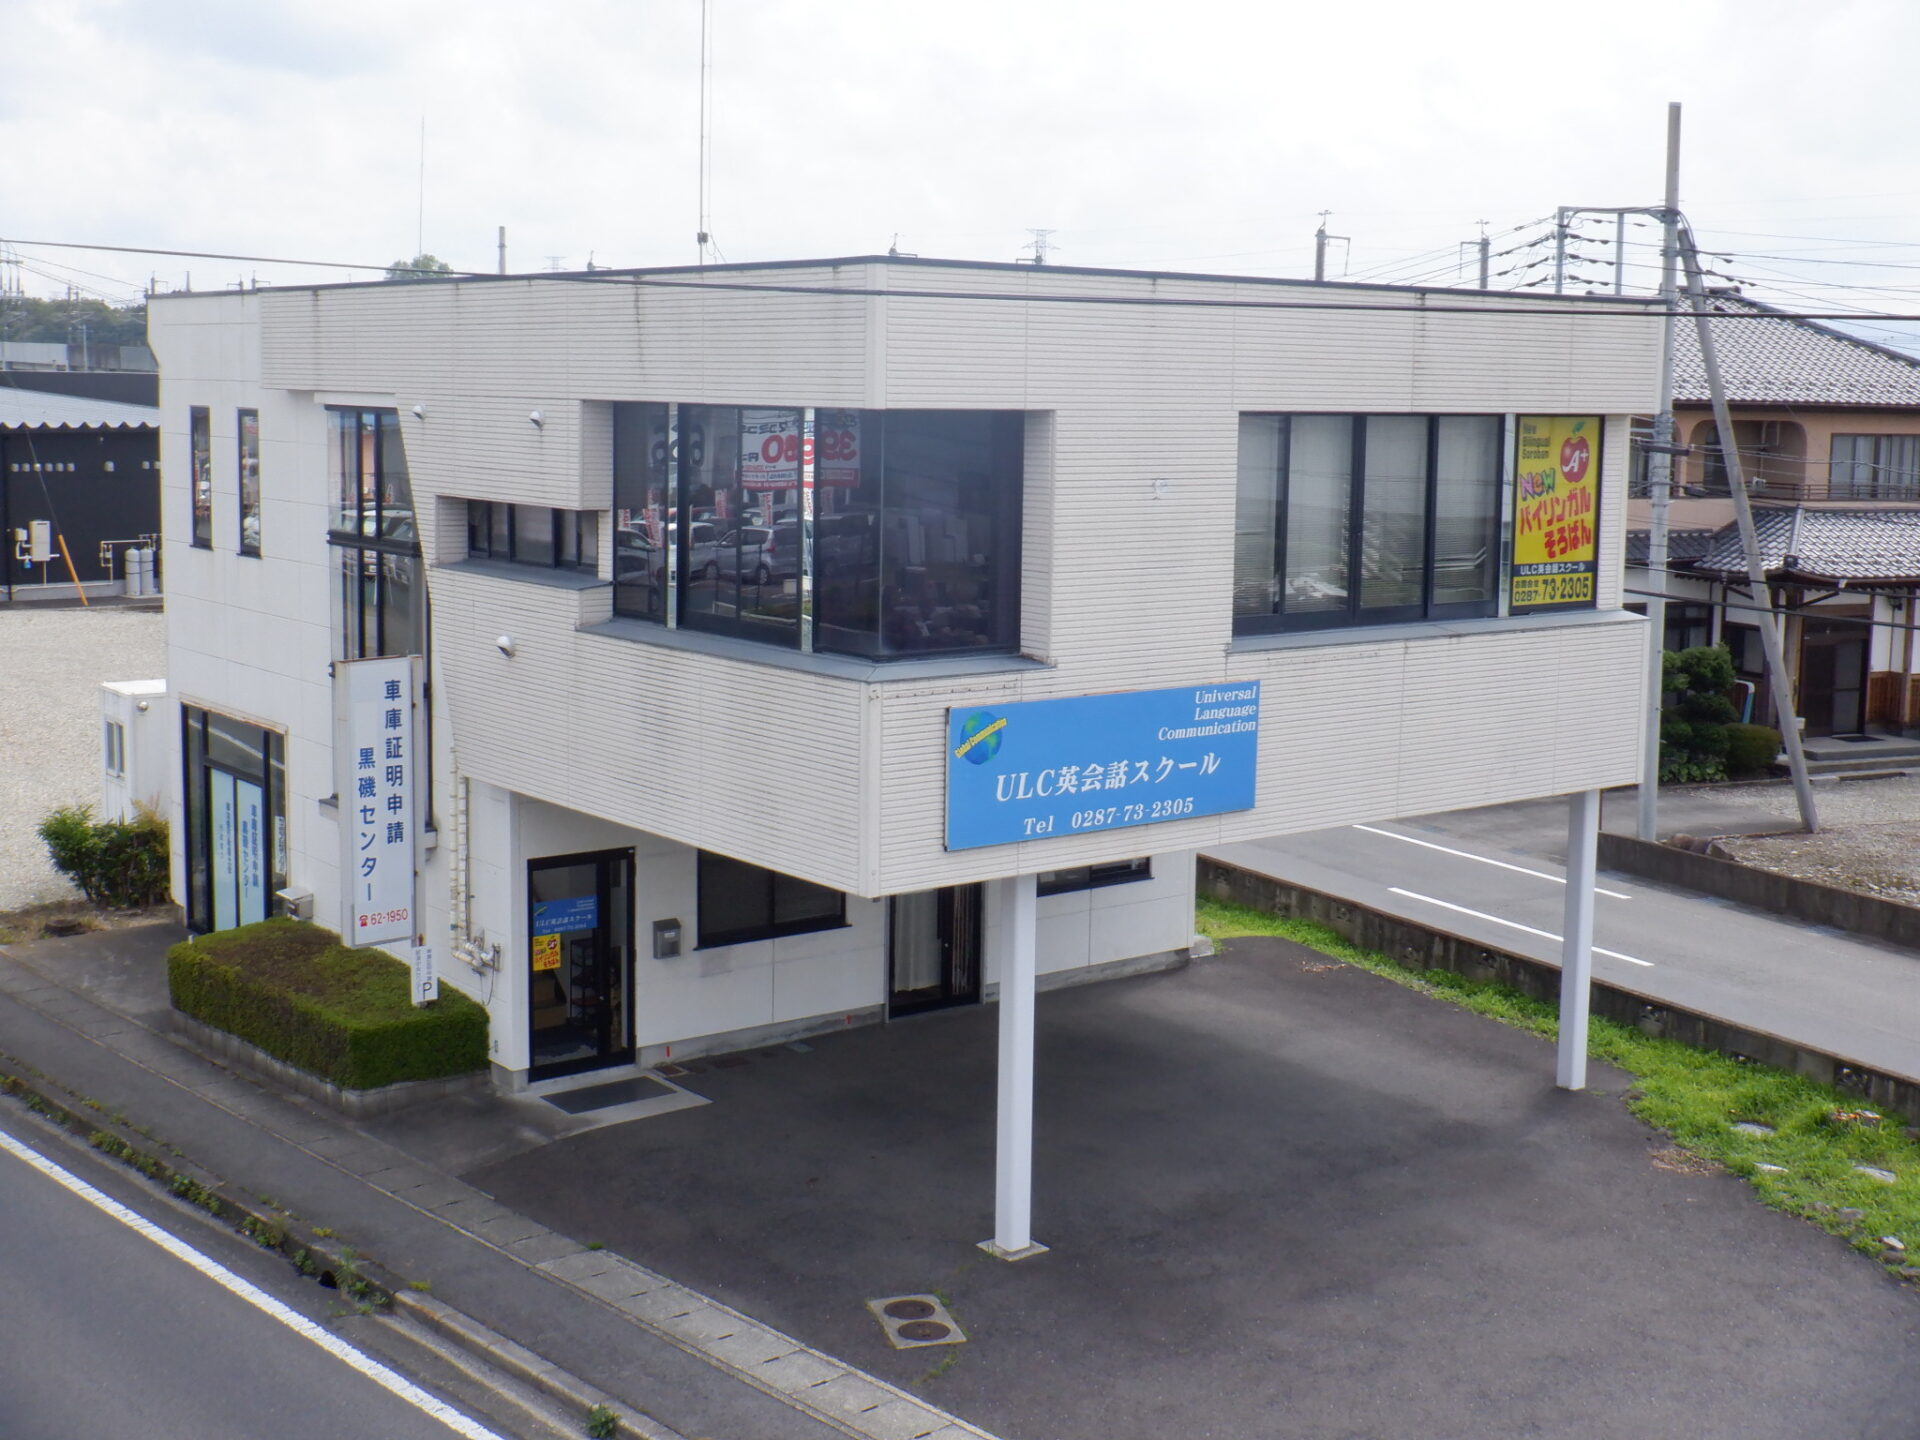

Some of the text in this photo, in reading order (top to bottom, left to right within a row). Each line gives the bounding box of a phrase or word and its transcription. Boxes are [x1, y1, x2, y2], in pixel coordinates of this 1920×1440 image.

[1520, 486, 1591, 536] バイリンガル
[1544, 518, 1592, 559] そろばん
[1194, 704, 1257, 721] Language
[1195, 686, 1257, 705] Universal
[1158, 719, 1256, 741] Communication
[384, 678, 404, 845] 車庫証明申請
[995, 752, 1221, 802] ULC英会話スクール
[358, 747, 377, 902] 黒磯センター
[1023, 797, 1194, 835] Tel 0287-73-2305
[370, 908, 409, 926] 62-1950
[422, 981, 433, 1001] P
